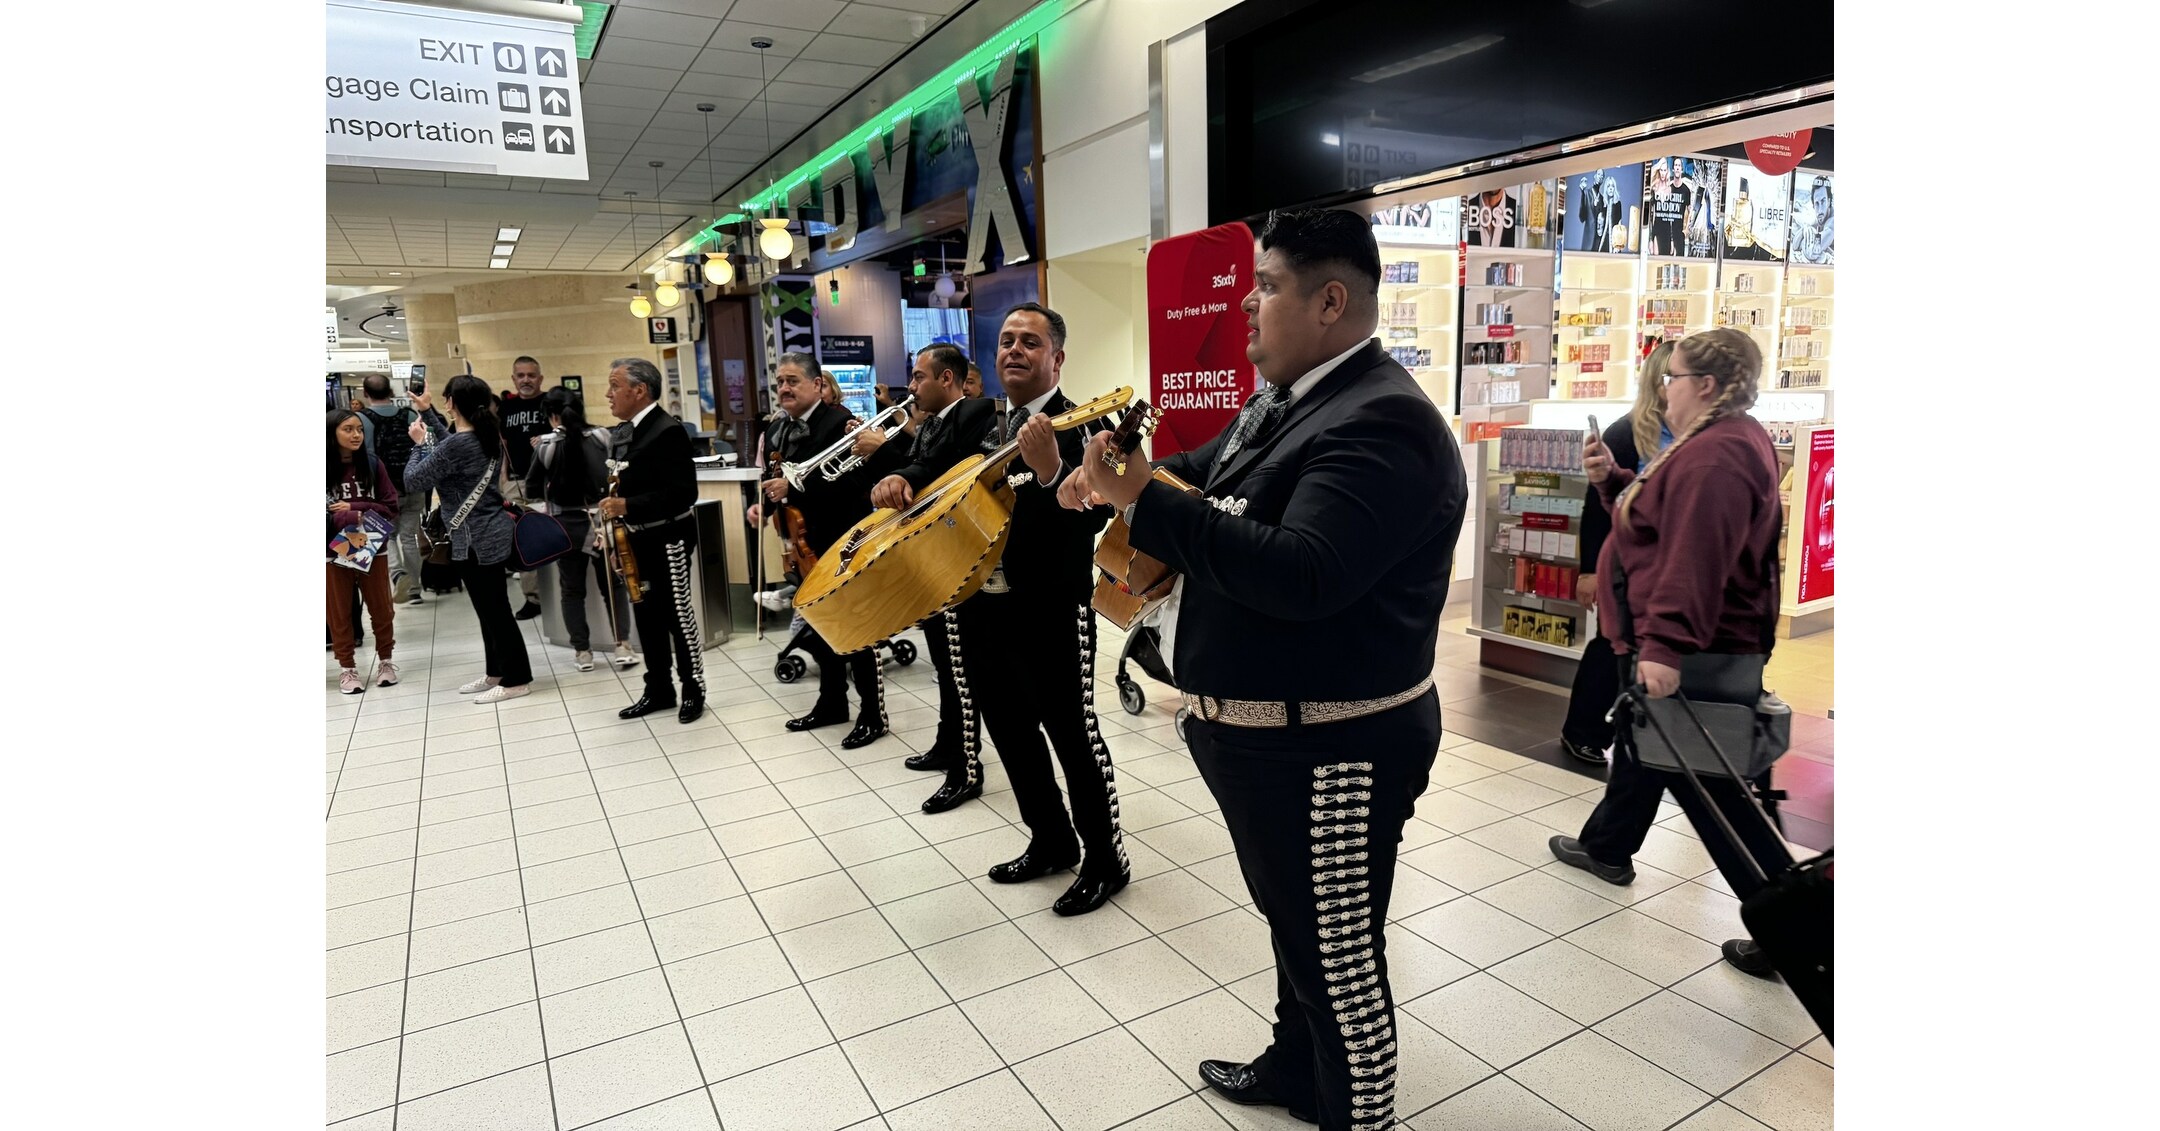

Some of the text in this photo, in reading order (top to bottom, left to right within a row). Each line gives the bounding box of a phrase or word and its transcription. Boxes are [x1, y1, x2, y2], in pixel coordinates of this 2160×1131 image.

[419, 38, 484, 65] EXIT
[409, 78, 489, 105] Claim
[326, 116, 494, 145] nsportation
[1468, 205, 1513, 229] BOSS
[1760, 207, 1784, 221] LIBRE
[1212, 274, 1236, 288] 3Sixty
[1167, 302, 1228, 320] Duty Free & More
[1162, 370, 1236, 390] BEST PRICE
[506, 411, 545, 428] HURLE
[1524, 478, 1550, 486] SAVINGS
